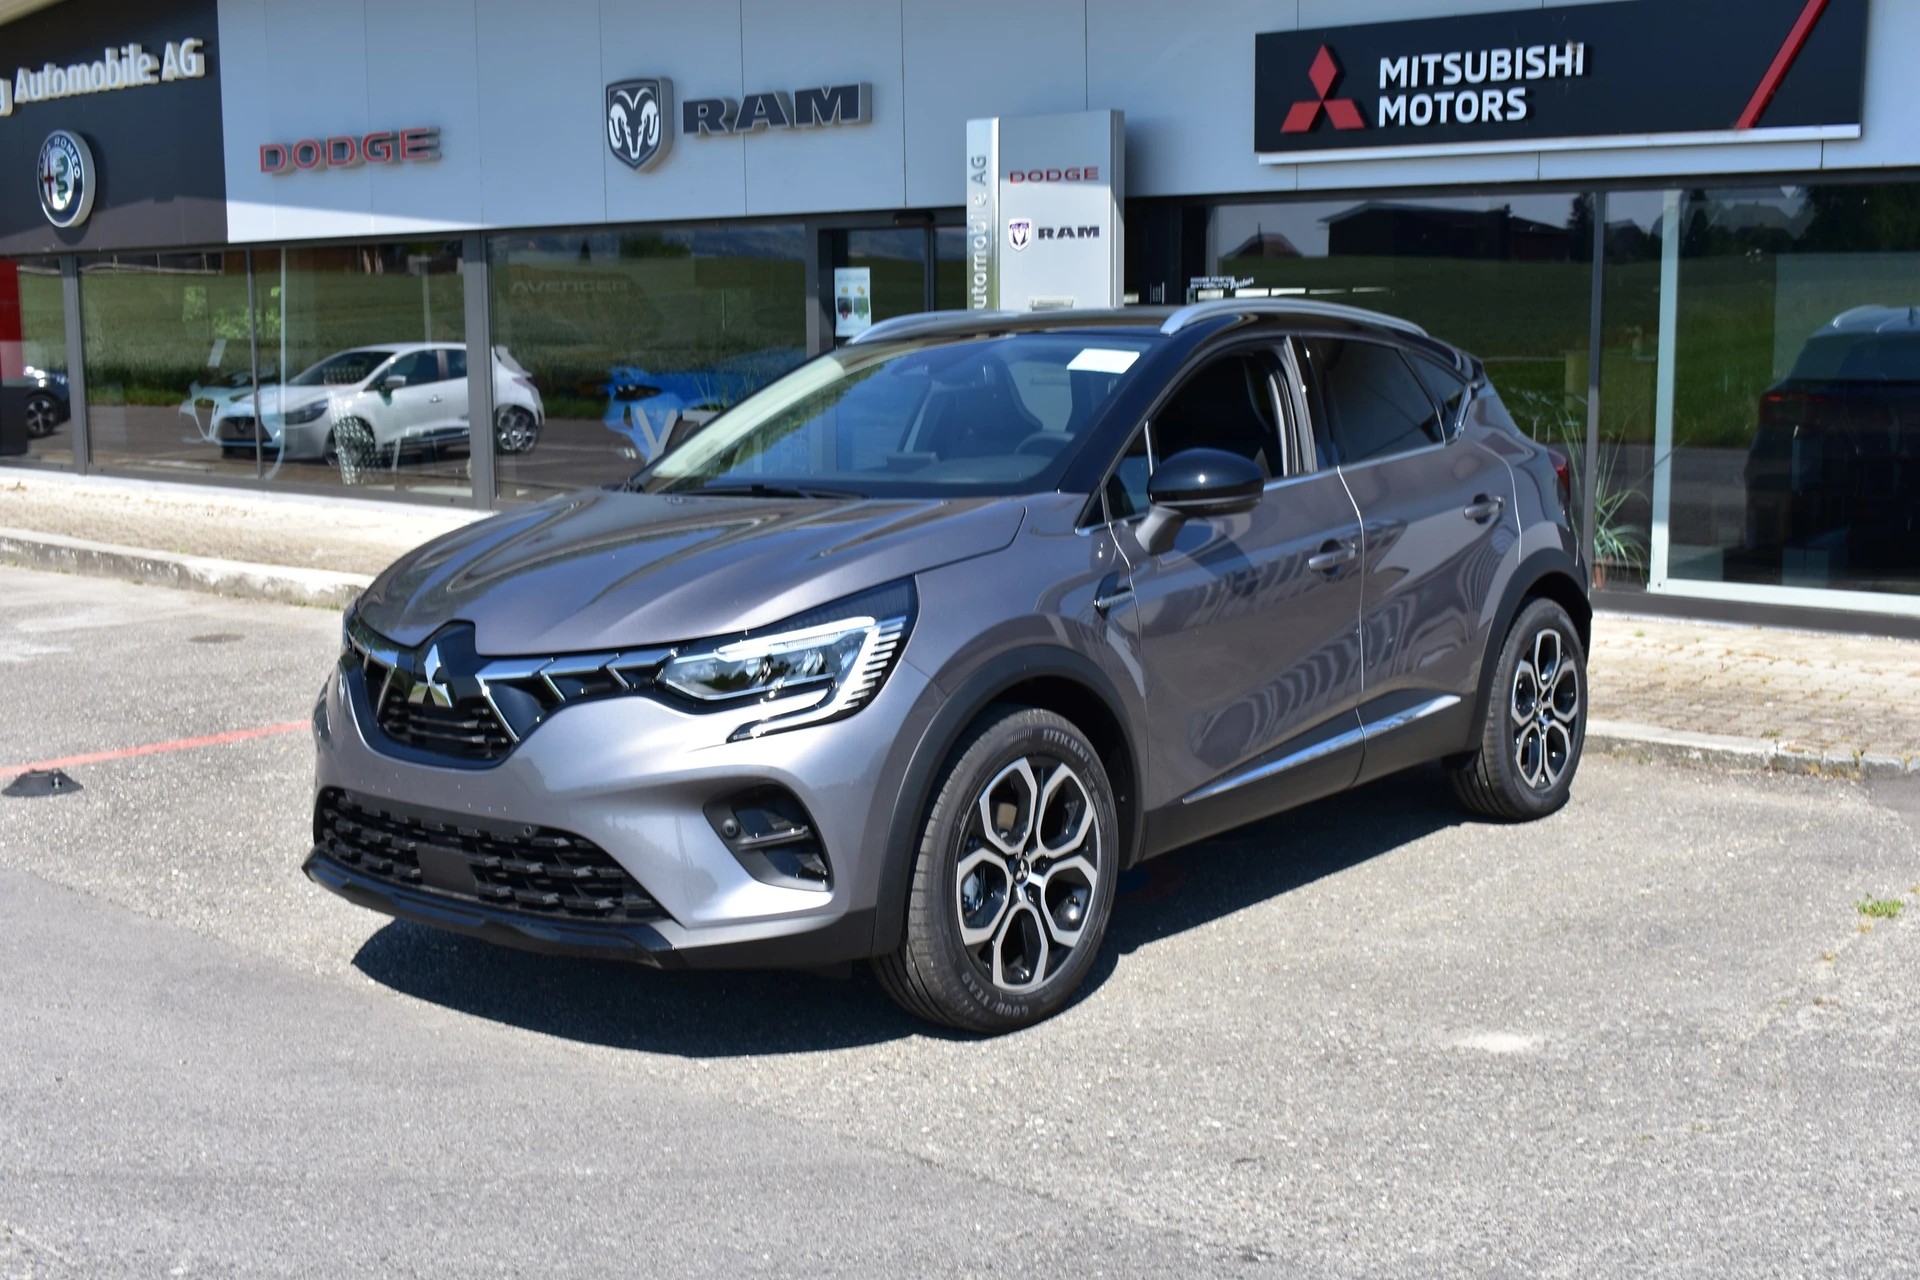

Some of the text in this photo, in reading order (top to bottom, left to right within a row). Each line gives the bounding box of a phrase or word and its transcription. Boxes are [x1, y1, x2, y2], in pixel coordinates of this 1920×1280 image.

[14, 42, 159, 103] Automobile
[161, 37, 205, 81] AG
[1379, 42, 1584, 89] MITSUBISHI
[683, 82, 872, 135] RAM
[1378, 87, 1527, 128] MOTORS
[259, 127, 441, 175] DODGE
[1009, 166, 1100, 184] DODGE
[971, 154, 987, 310] utomobile AG
[1037, 226, 1100, 240] RAM
